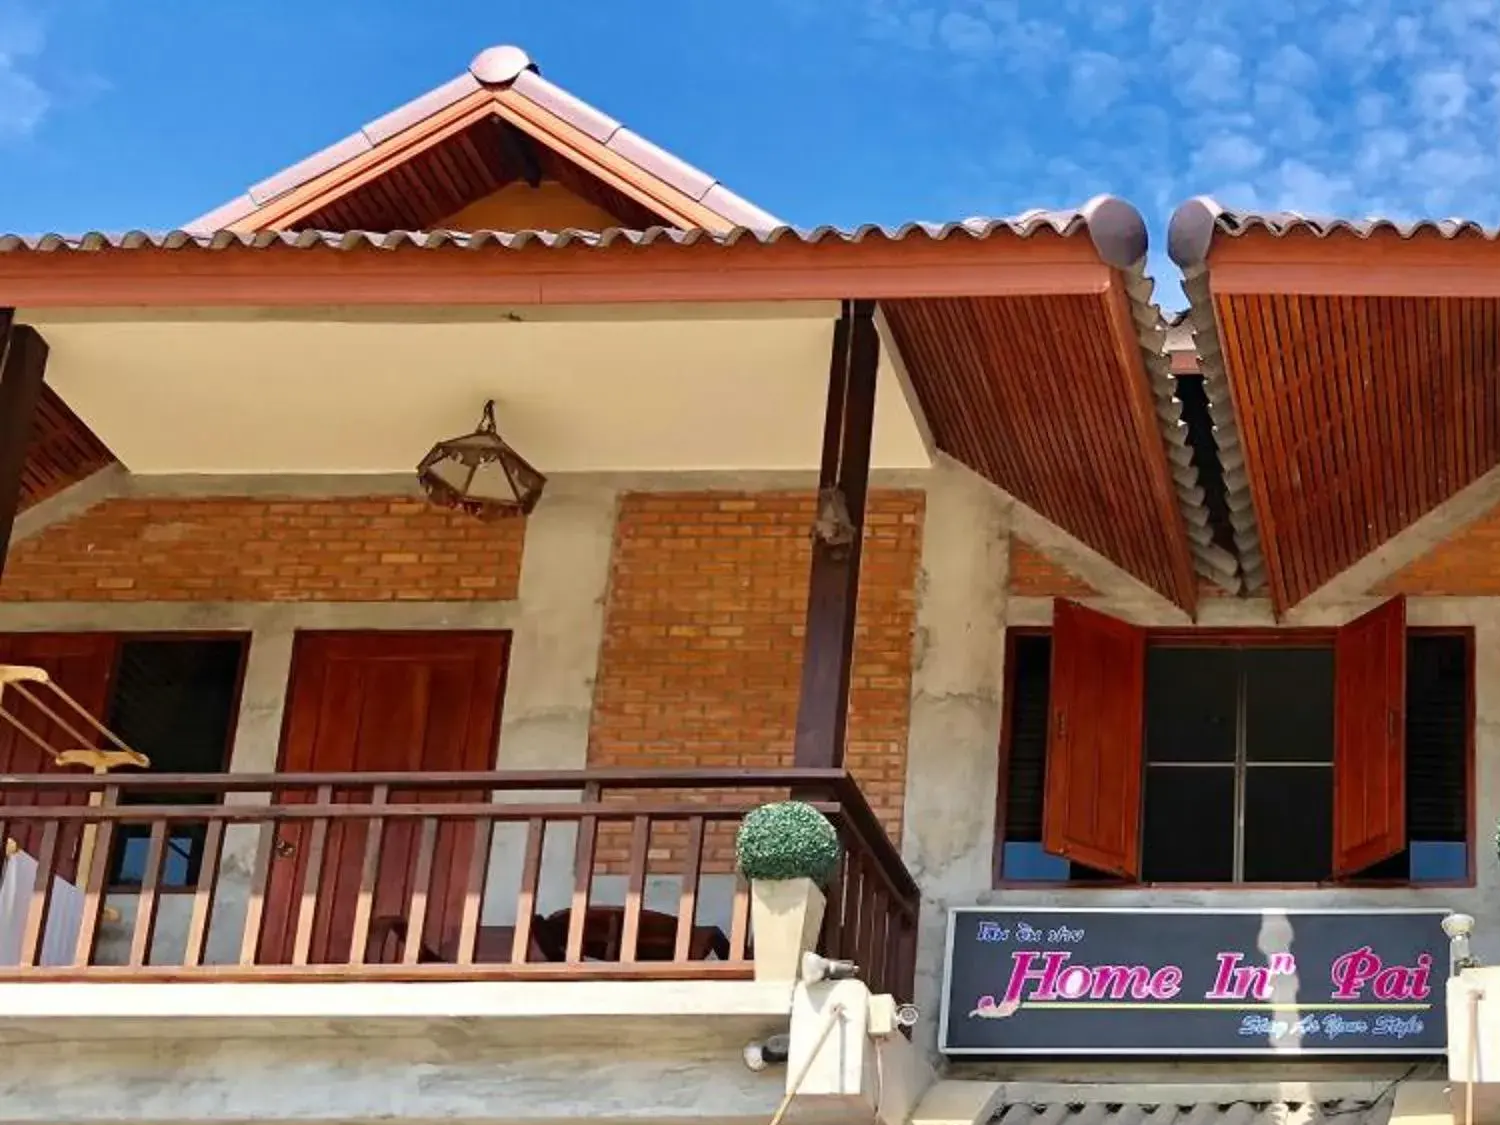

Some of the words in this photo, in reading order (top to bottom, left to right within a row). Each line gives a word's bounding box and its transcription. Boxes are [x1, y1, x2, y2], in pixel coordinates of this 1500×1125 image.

[968, 949, 1184, 1018] Home
[1205, 950, 1296, 1000] Inn
[1331, 946, 1433, 1000] Pai
[1372, 1014, 1425, 1039] Style
